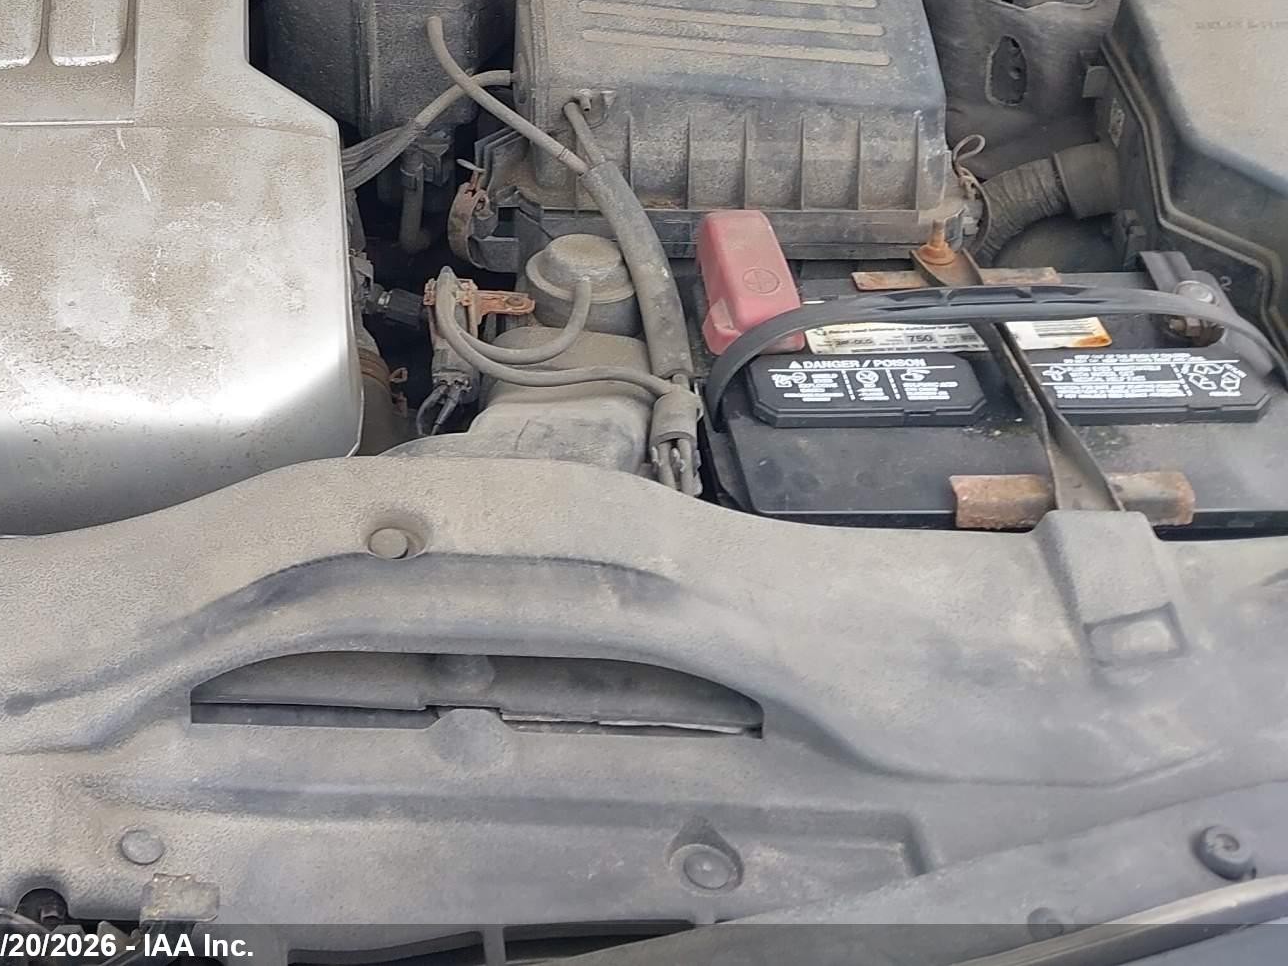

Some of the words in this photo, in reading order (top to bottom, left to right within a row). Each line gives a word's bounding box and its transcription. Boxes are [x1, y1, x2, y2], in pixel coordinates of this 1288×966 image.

[906, 334, 933, 343] 750
[802, 359, 860, 369] DANGER
[873, 358, 927, 368] POISON
